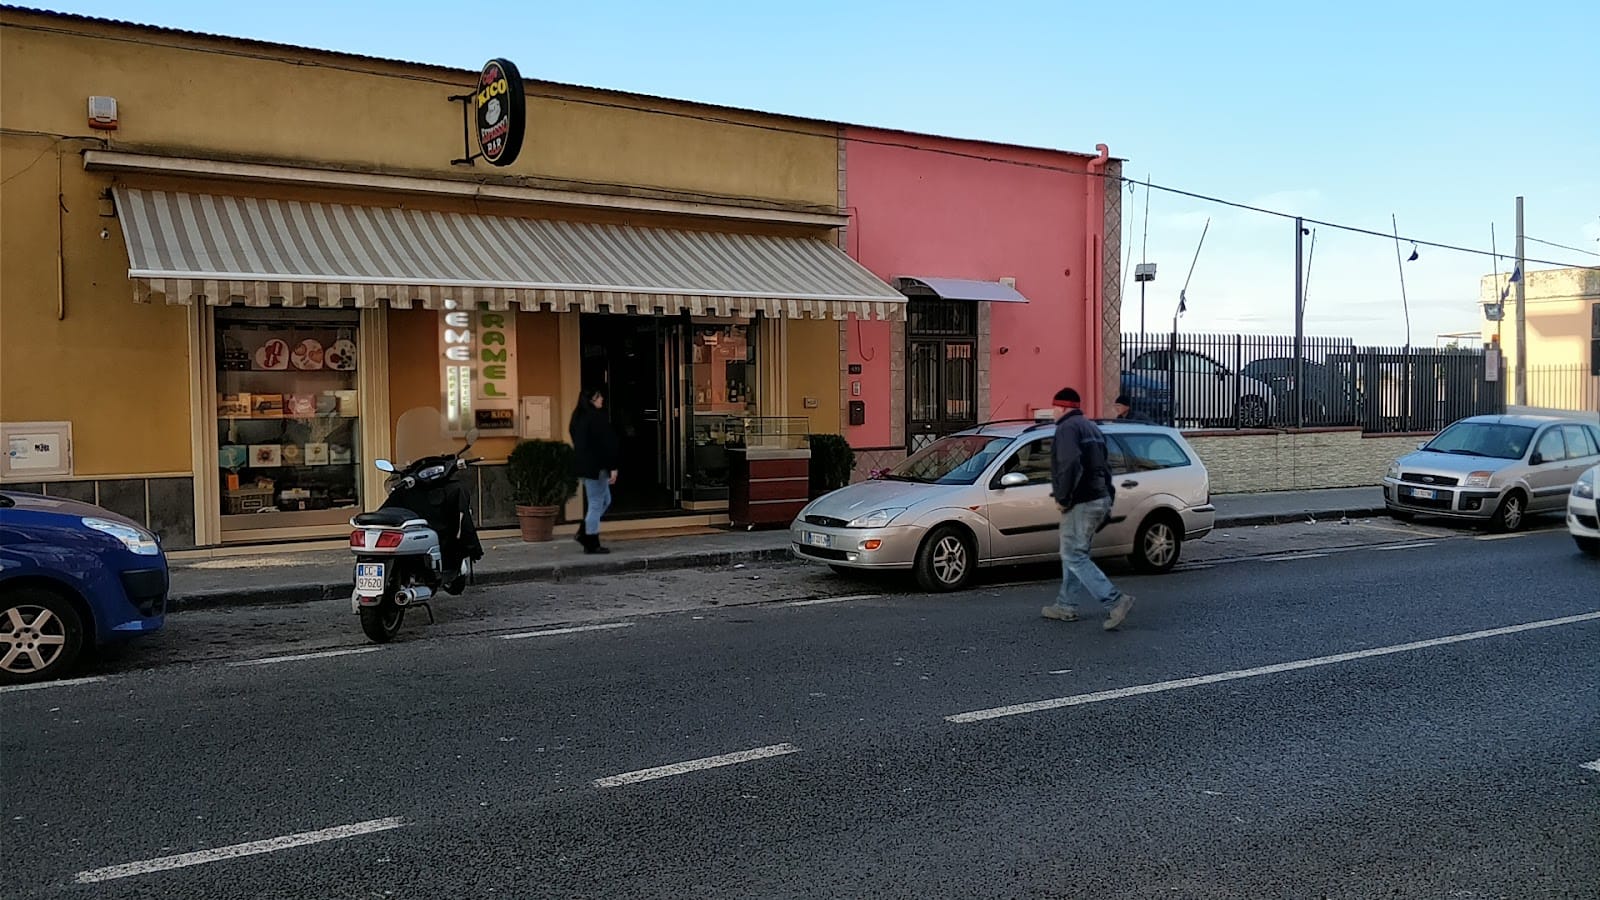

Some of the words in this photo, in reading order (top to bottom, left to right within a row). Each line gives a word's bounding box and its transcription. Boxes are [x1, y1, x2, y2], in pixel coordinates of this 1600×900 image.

[478, 78, 507, 109] KICO
[487, 138, 502, 155] BAR
[481, 302, 507, 396] RAMEL
[359, 578, 382, 588] 97620
